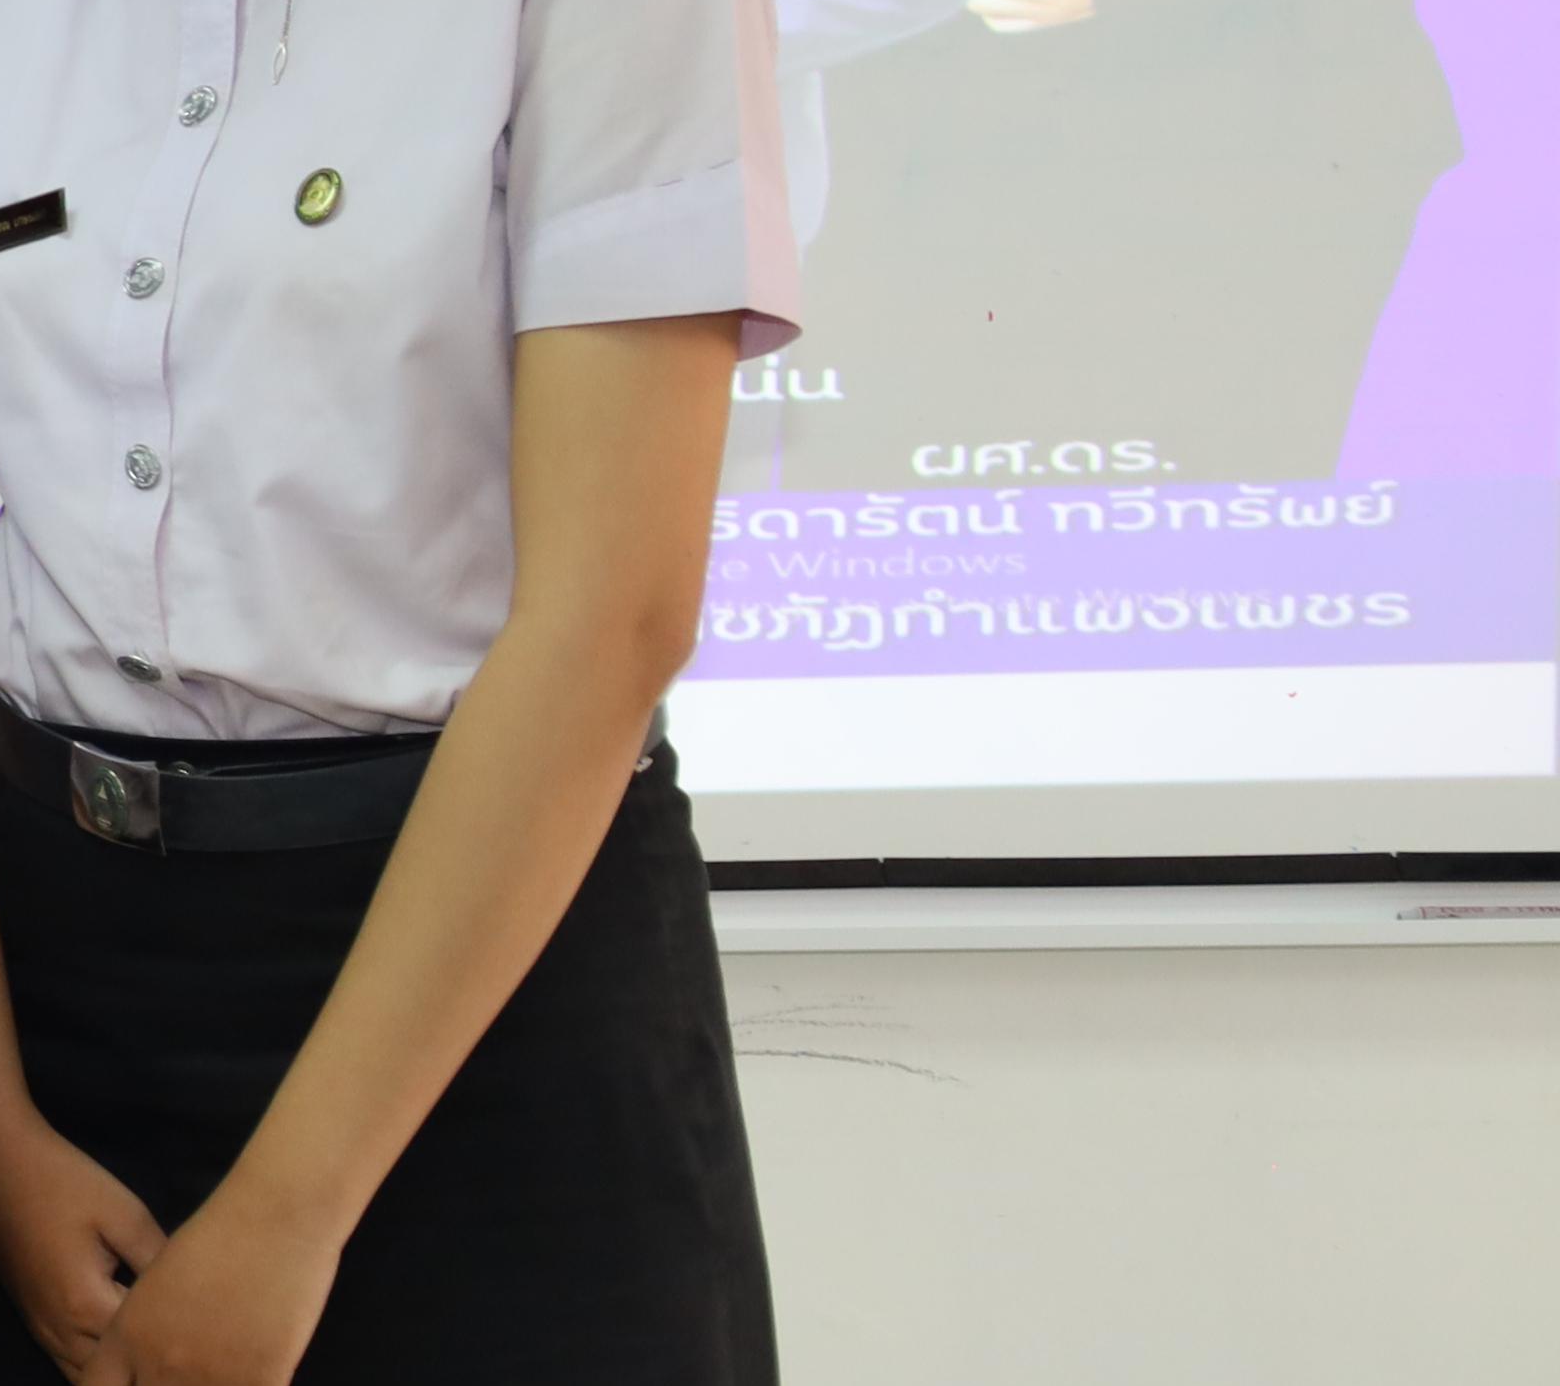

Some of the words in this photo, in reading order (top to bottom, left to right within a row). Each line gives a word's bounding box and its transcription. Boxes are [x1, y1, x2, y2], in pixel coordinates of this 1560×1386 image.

[911, 439, 1178, 477] ผศ.ดร.
[1047, 480, 1400, 532] ทวีทรัพย์
[768, 545, 1028, 579] Windows
[696, 587, 1413, 651] ชภัฏกำแพงเพชร
